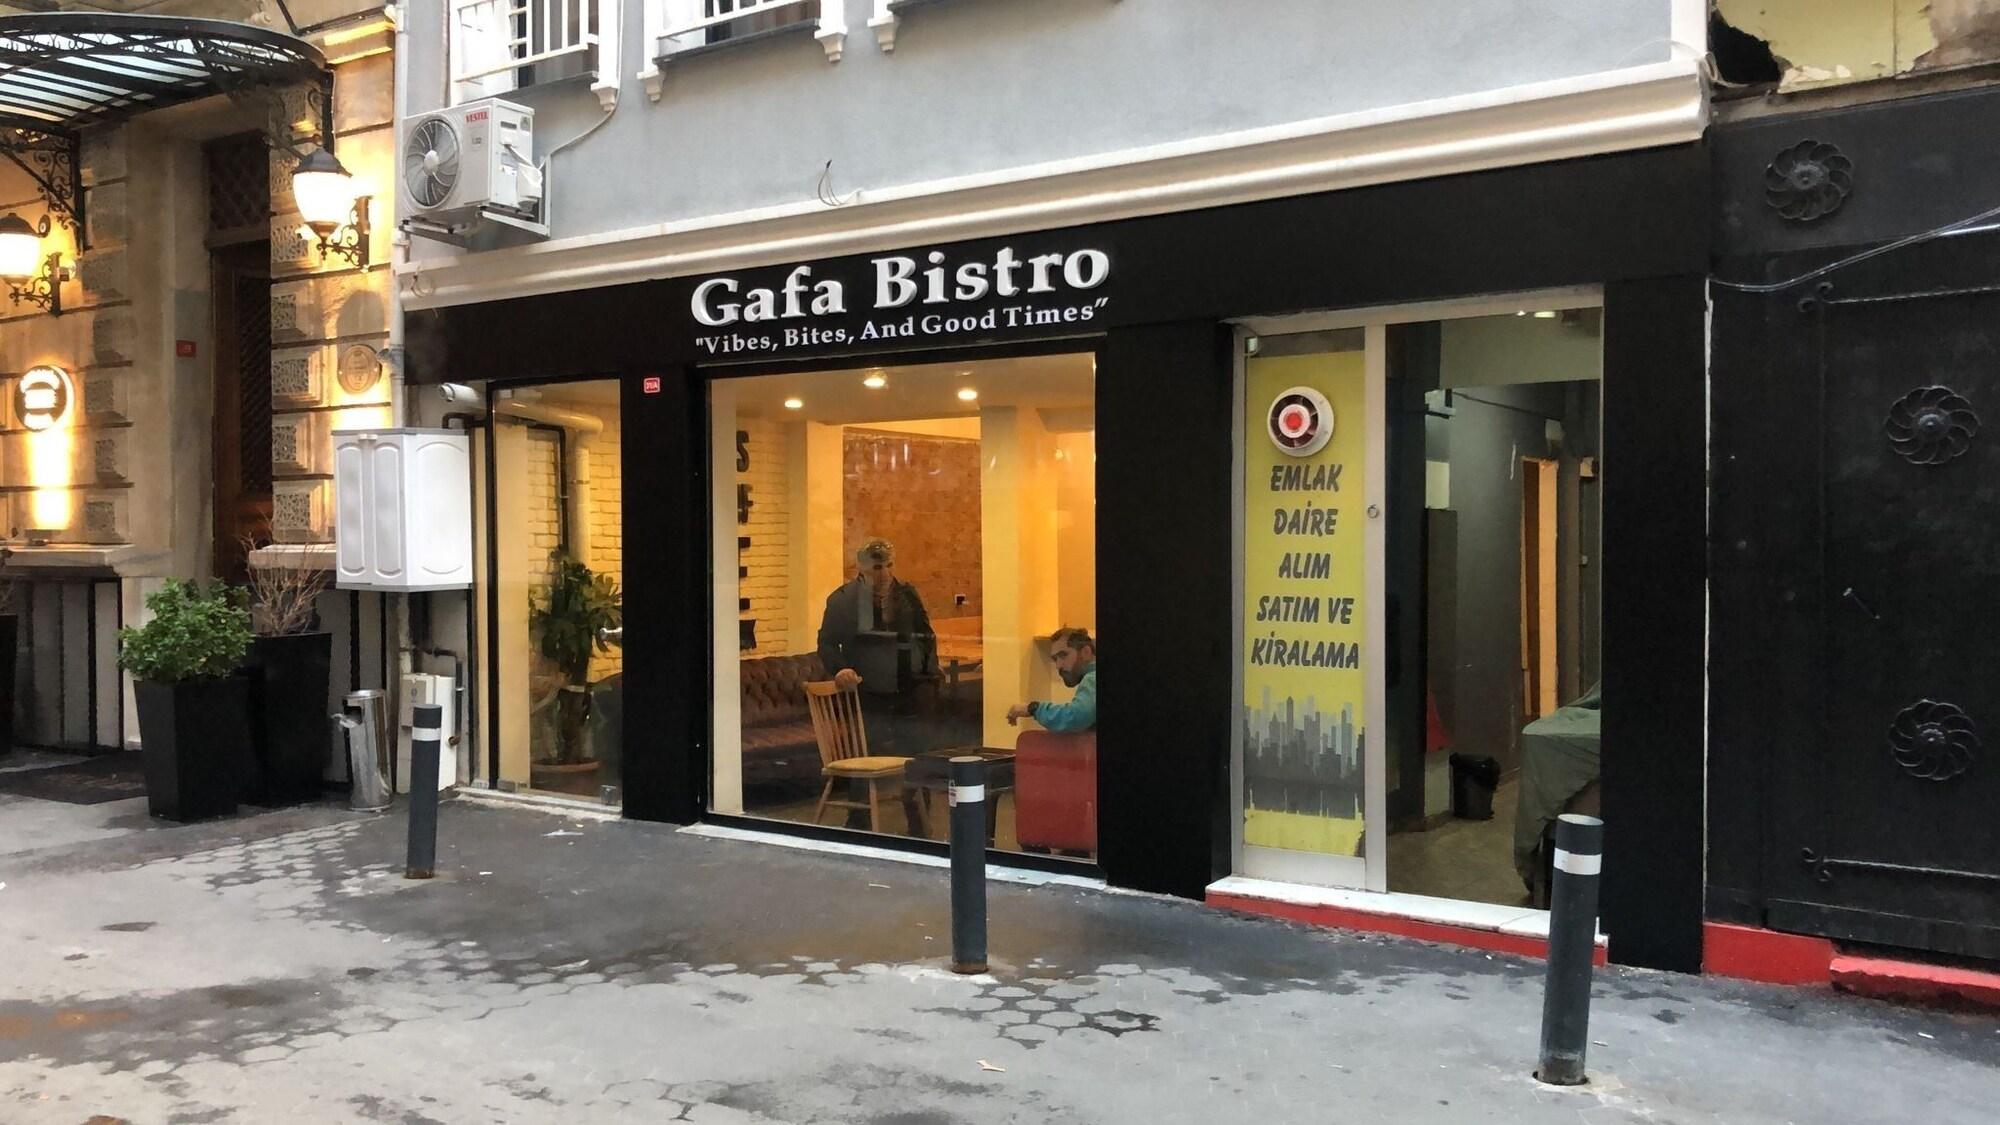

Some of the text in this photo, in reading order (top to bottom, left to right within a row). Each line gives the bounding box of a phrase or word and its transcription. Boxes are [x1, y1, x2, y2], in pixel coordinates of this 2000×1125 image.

[690, 247, 1110, 327] Gafa Bistro
[695, 333, 779, 354] "Vibes,
[784, 327, 855, 347] Bites,
[860, 317, 916, 340] And
[921, 308, 997, 335] Good
[1270, 463, 1343, 493] EMLAK
[1273, 500, 1339, 537] DAİRE
[1278, 552, 1331, 580] ALIM
[1256, 595, 1355, 625] SATIM VE
[1250, 631, 1360, 670] KİRALAMA
